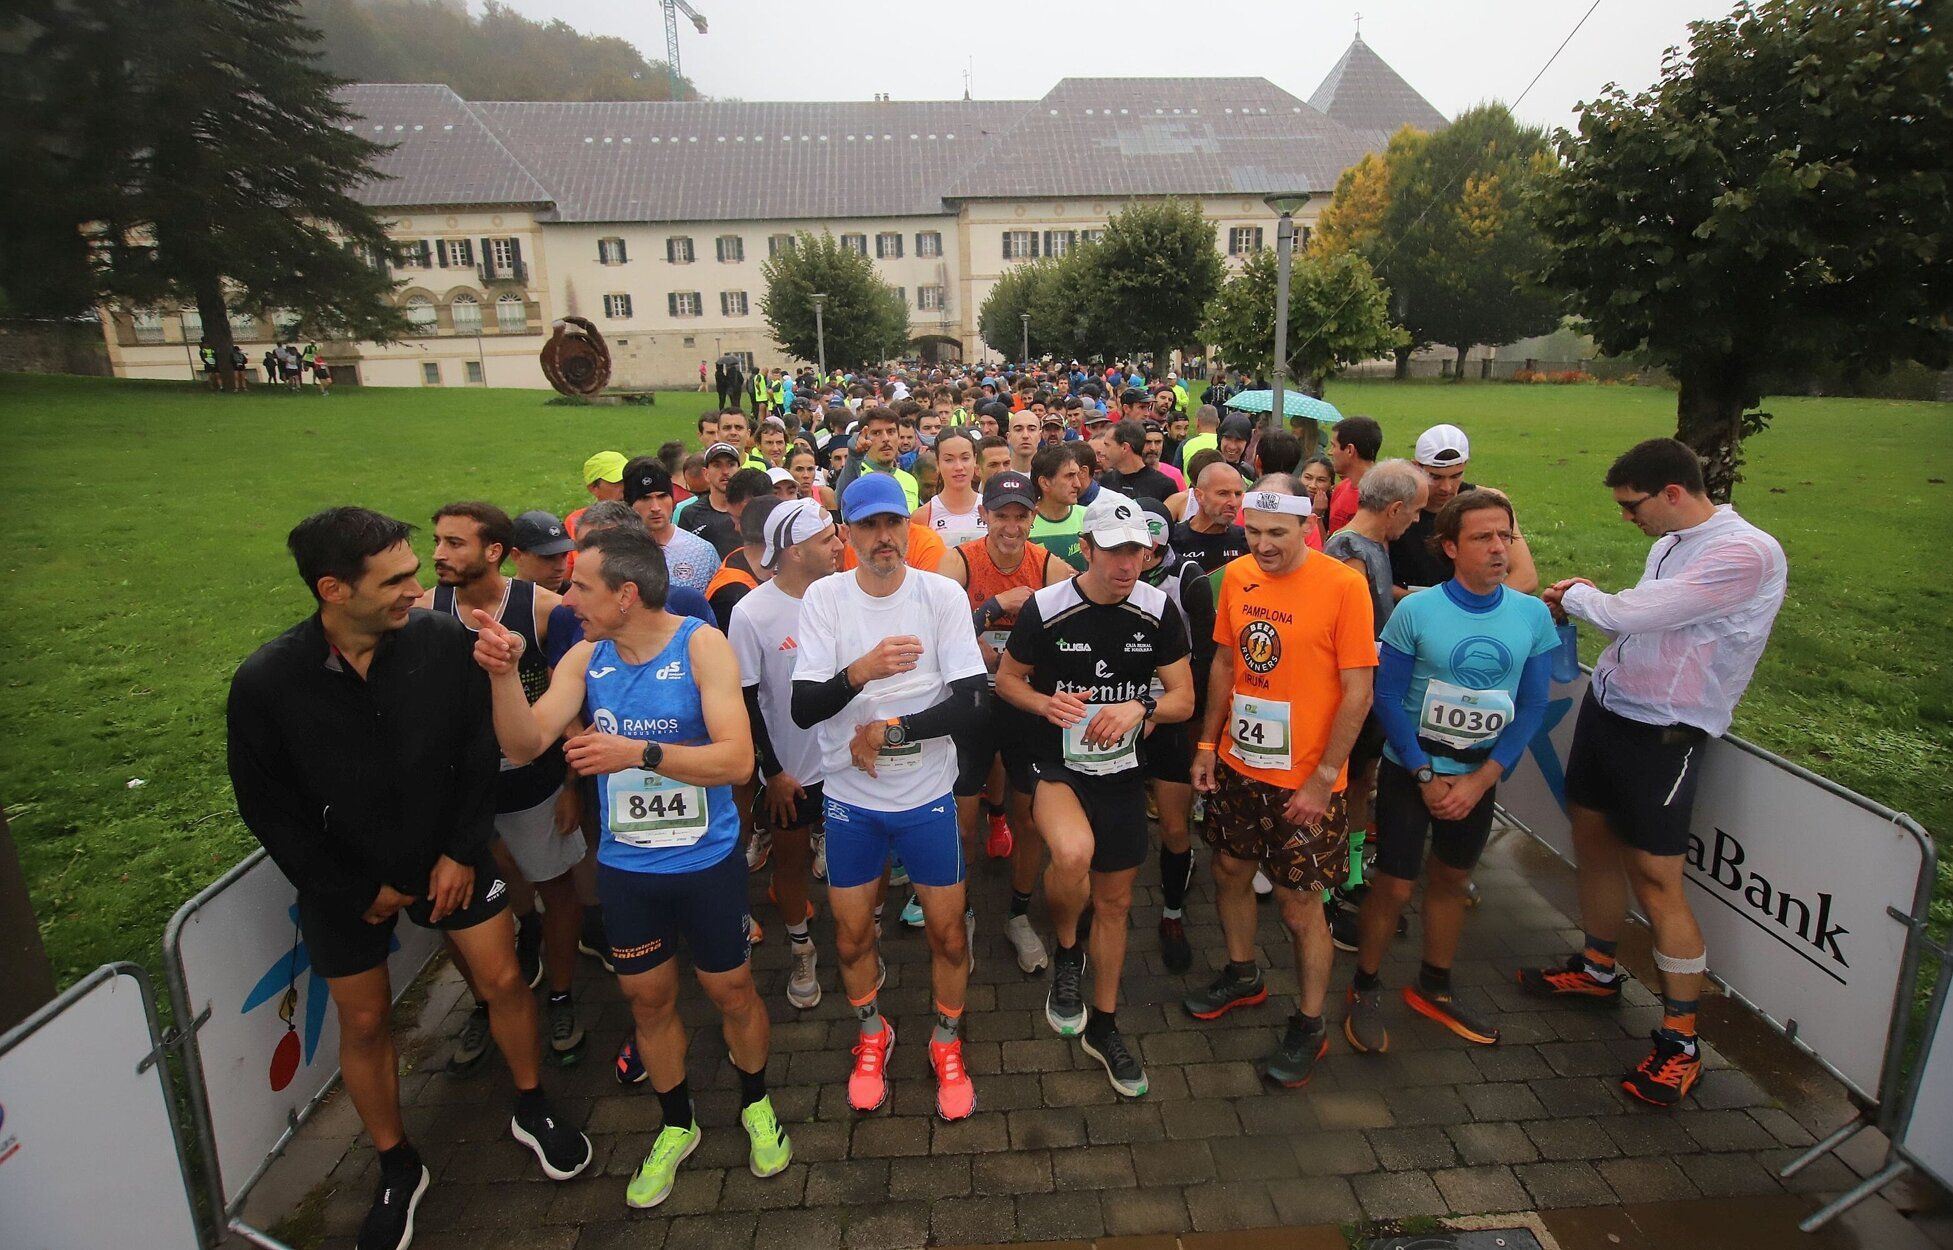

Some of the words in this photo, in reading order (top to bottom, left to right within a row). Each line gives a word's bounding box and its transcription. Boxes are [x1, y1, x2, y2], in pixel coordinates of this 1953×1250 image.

[1242, 604, 1293, 625] PAMPLONA
[1249, 622, 1276, 637] BEER
[1241, 646, 1278, 671] RUNNERS
[1244, 672, 1270, 690] IRUÑA
[623, 719, 678, 731] RAMOS
[1434, 705, 1503, 731] 1030
[623, 728, 679, 736] INDUSTRIAL
[1238, 718, 1265, 745] 24
[629, 792, 687, 819] 844
